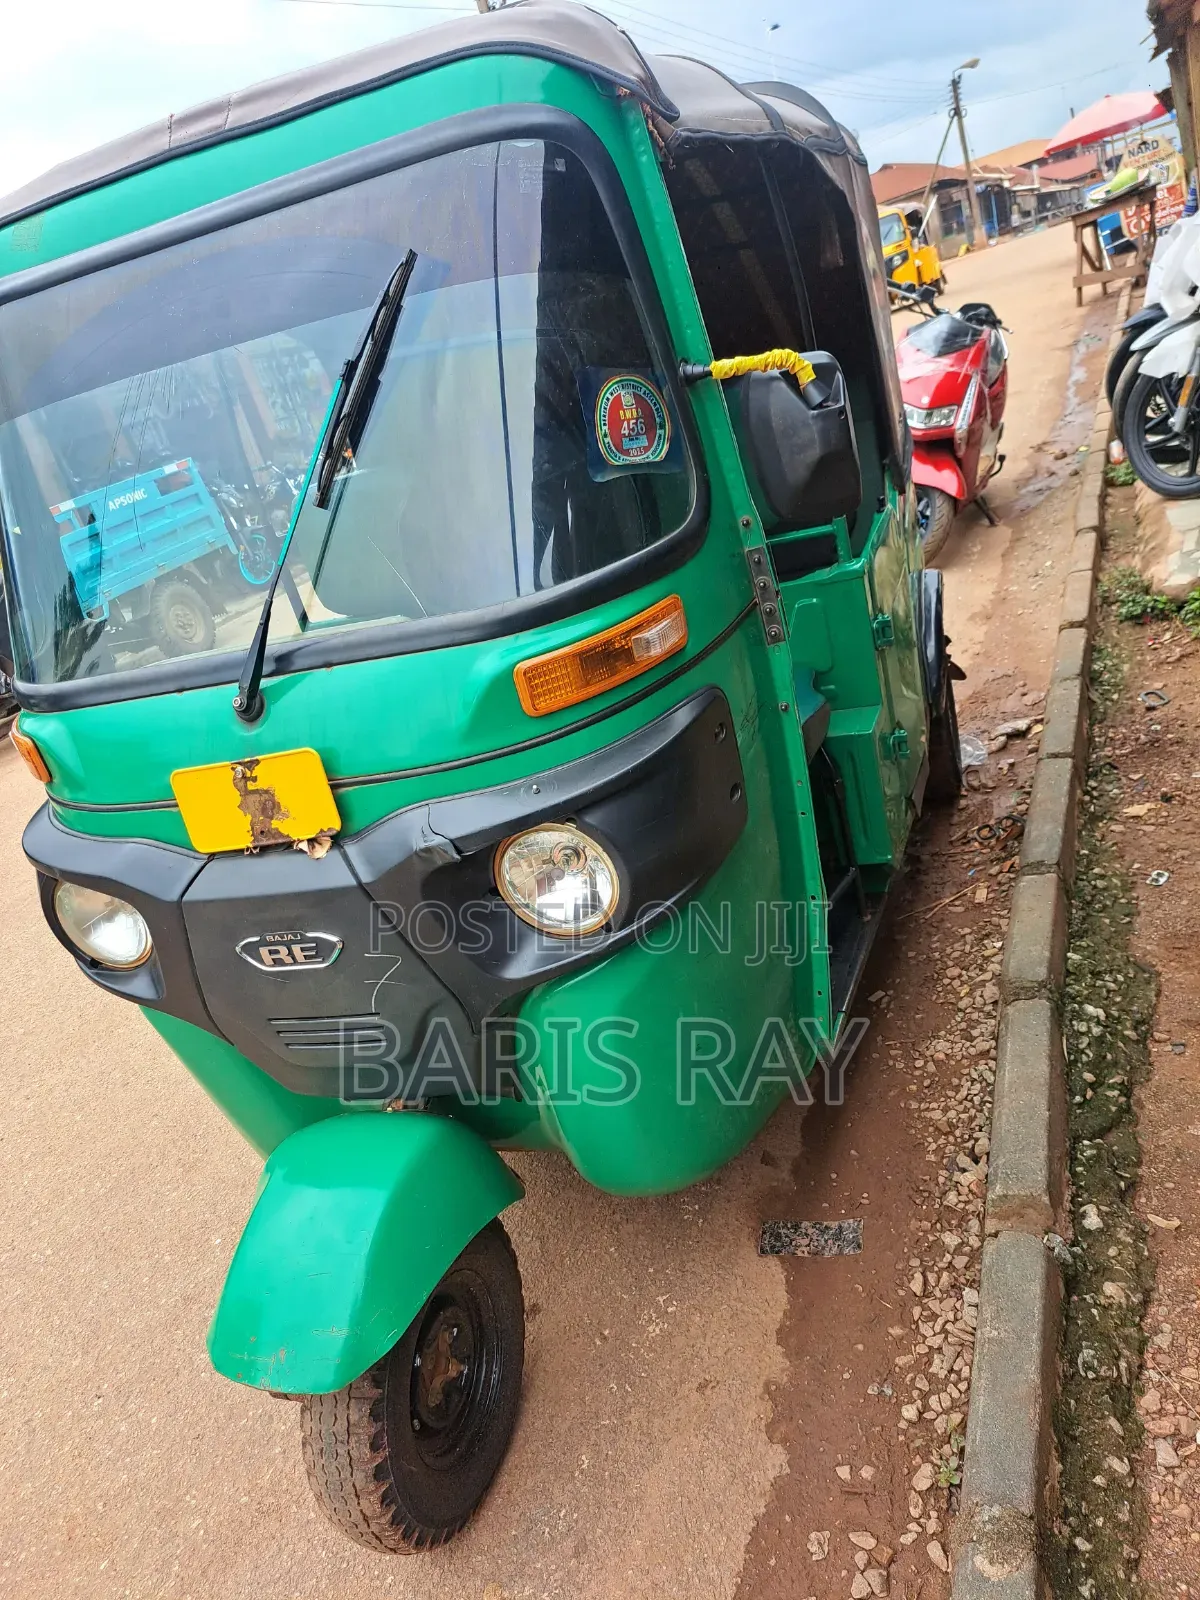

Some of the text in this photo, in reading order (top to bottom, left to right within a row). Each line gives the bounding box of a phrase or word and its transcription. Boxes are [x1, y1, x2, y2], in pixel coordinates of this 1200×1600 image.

[608, 385, 621, 397] WEST
[621, 383, 643, 393] DISTRICT
[642, 390, 664, 420] ASSEMBLY
[621, 419, 646, 437] 456
[629, 447, 645, 457] 2025
[108, 487, 148, 512] APSONIC
[266, 933, 301, 942] BAJAJ
[259, 943, 324, 966] RE
